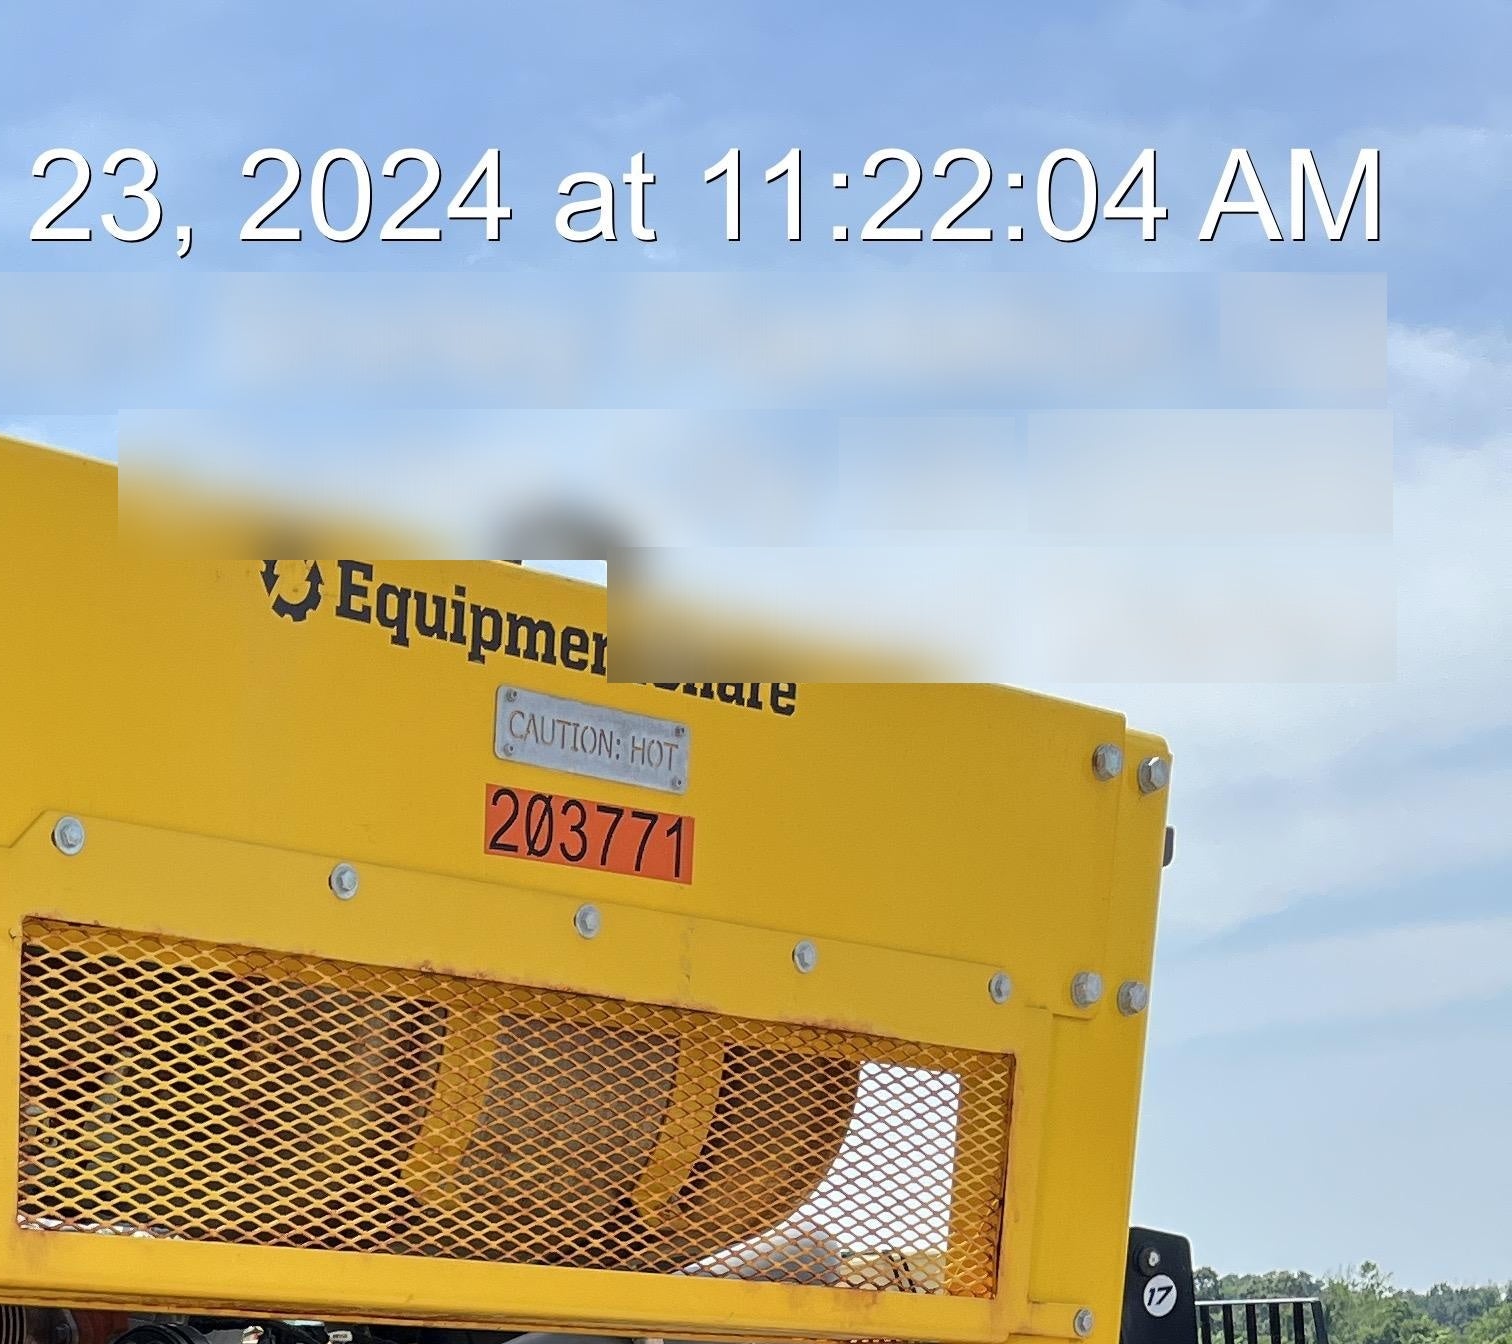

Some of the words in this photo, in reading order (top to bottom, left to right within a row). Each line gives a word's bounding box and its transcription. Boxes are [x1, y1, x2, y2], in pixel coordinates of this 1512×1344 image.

[509, 710, 621, 760] CAUTION:
[630, 735, 679, 771] HOT
[489, 788, 683, 878] 203771
[1147, 1285, 1174, 1306] 17
